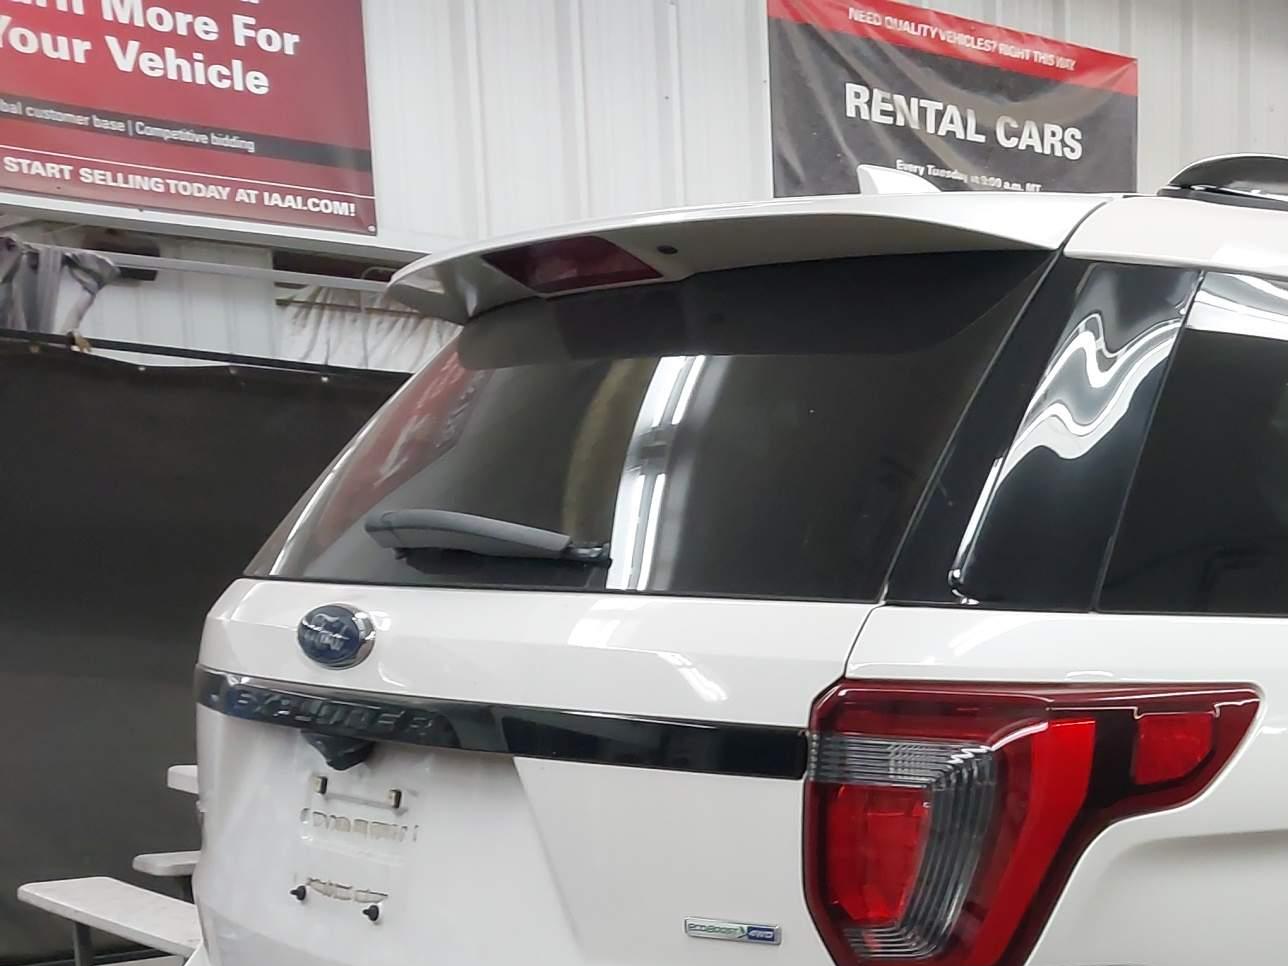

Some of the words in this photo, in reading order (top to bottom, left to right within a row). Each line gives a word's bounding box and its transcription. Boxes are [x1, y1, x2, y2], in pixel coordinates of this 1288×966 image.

[101, 0, 219, 41] More
[232, 14, 300, 55] For
[848, 7, 882, 26] NEED
[885, 16, 938, 39] QUALITY
[1033, 50, 1056, 66] THIS
[104, 35, 269, 95] Vehicle
[26, 107, 90, 126] customer
[92, 114, 126, 131] base
[135, 121, 209, 144] Competitive
[210, 132, 256, 153] bidding
[845, 82, 986, 144] RENTAL
[996, 115, 1083, 160] CARS
[3, 156, 74, 180] START
[79, 167, 165, 193] SELLING
[166, 178, 231, 200] TODAY
[235, 188, 259, 204] AT
[263, 191, 355, 217] IAAI.COM!
[896, 159, 925, 176] Every
[926, 165, 969, 184] Tuesday
